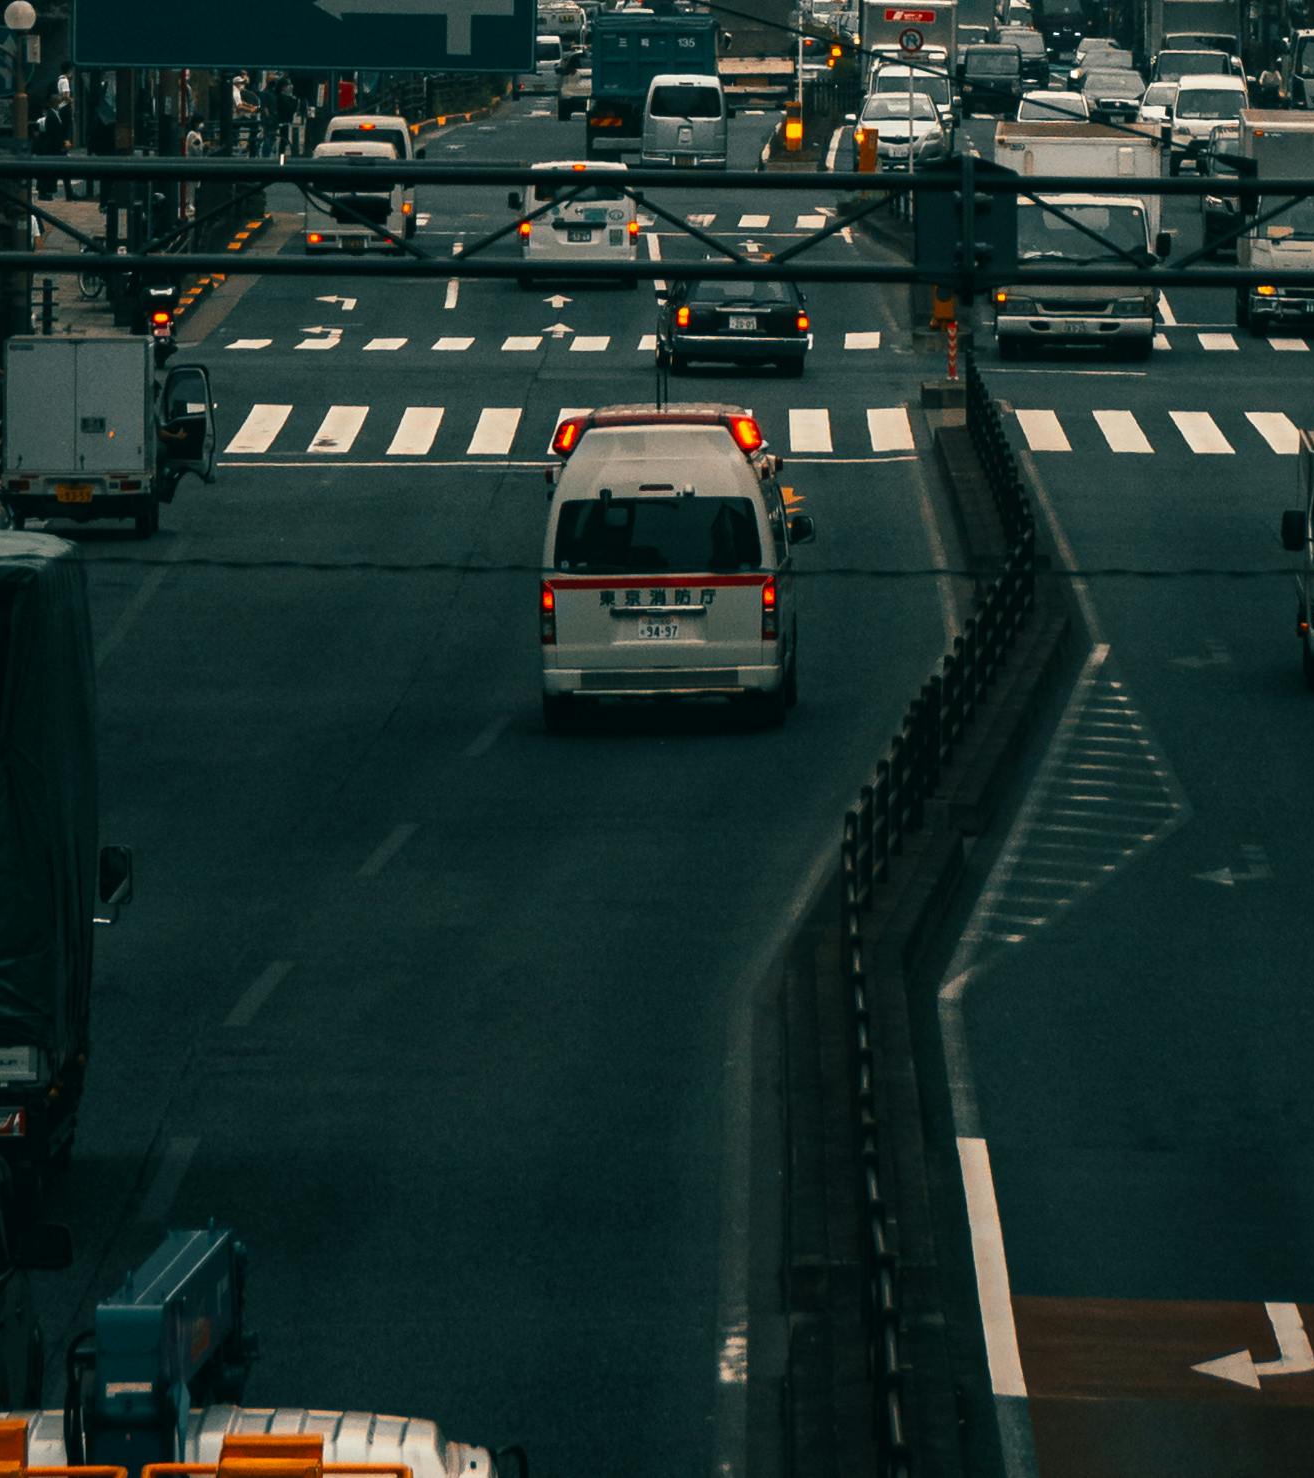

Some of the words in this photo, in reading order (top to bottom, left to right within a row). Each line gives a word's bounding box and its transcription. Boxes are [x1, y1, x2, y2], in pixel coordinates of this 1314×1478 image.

[599, 589, 717, 606] 東京消防庁
